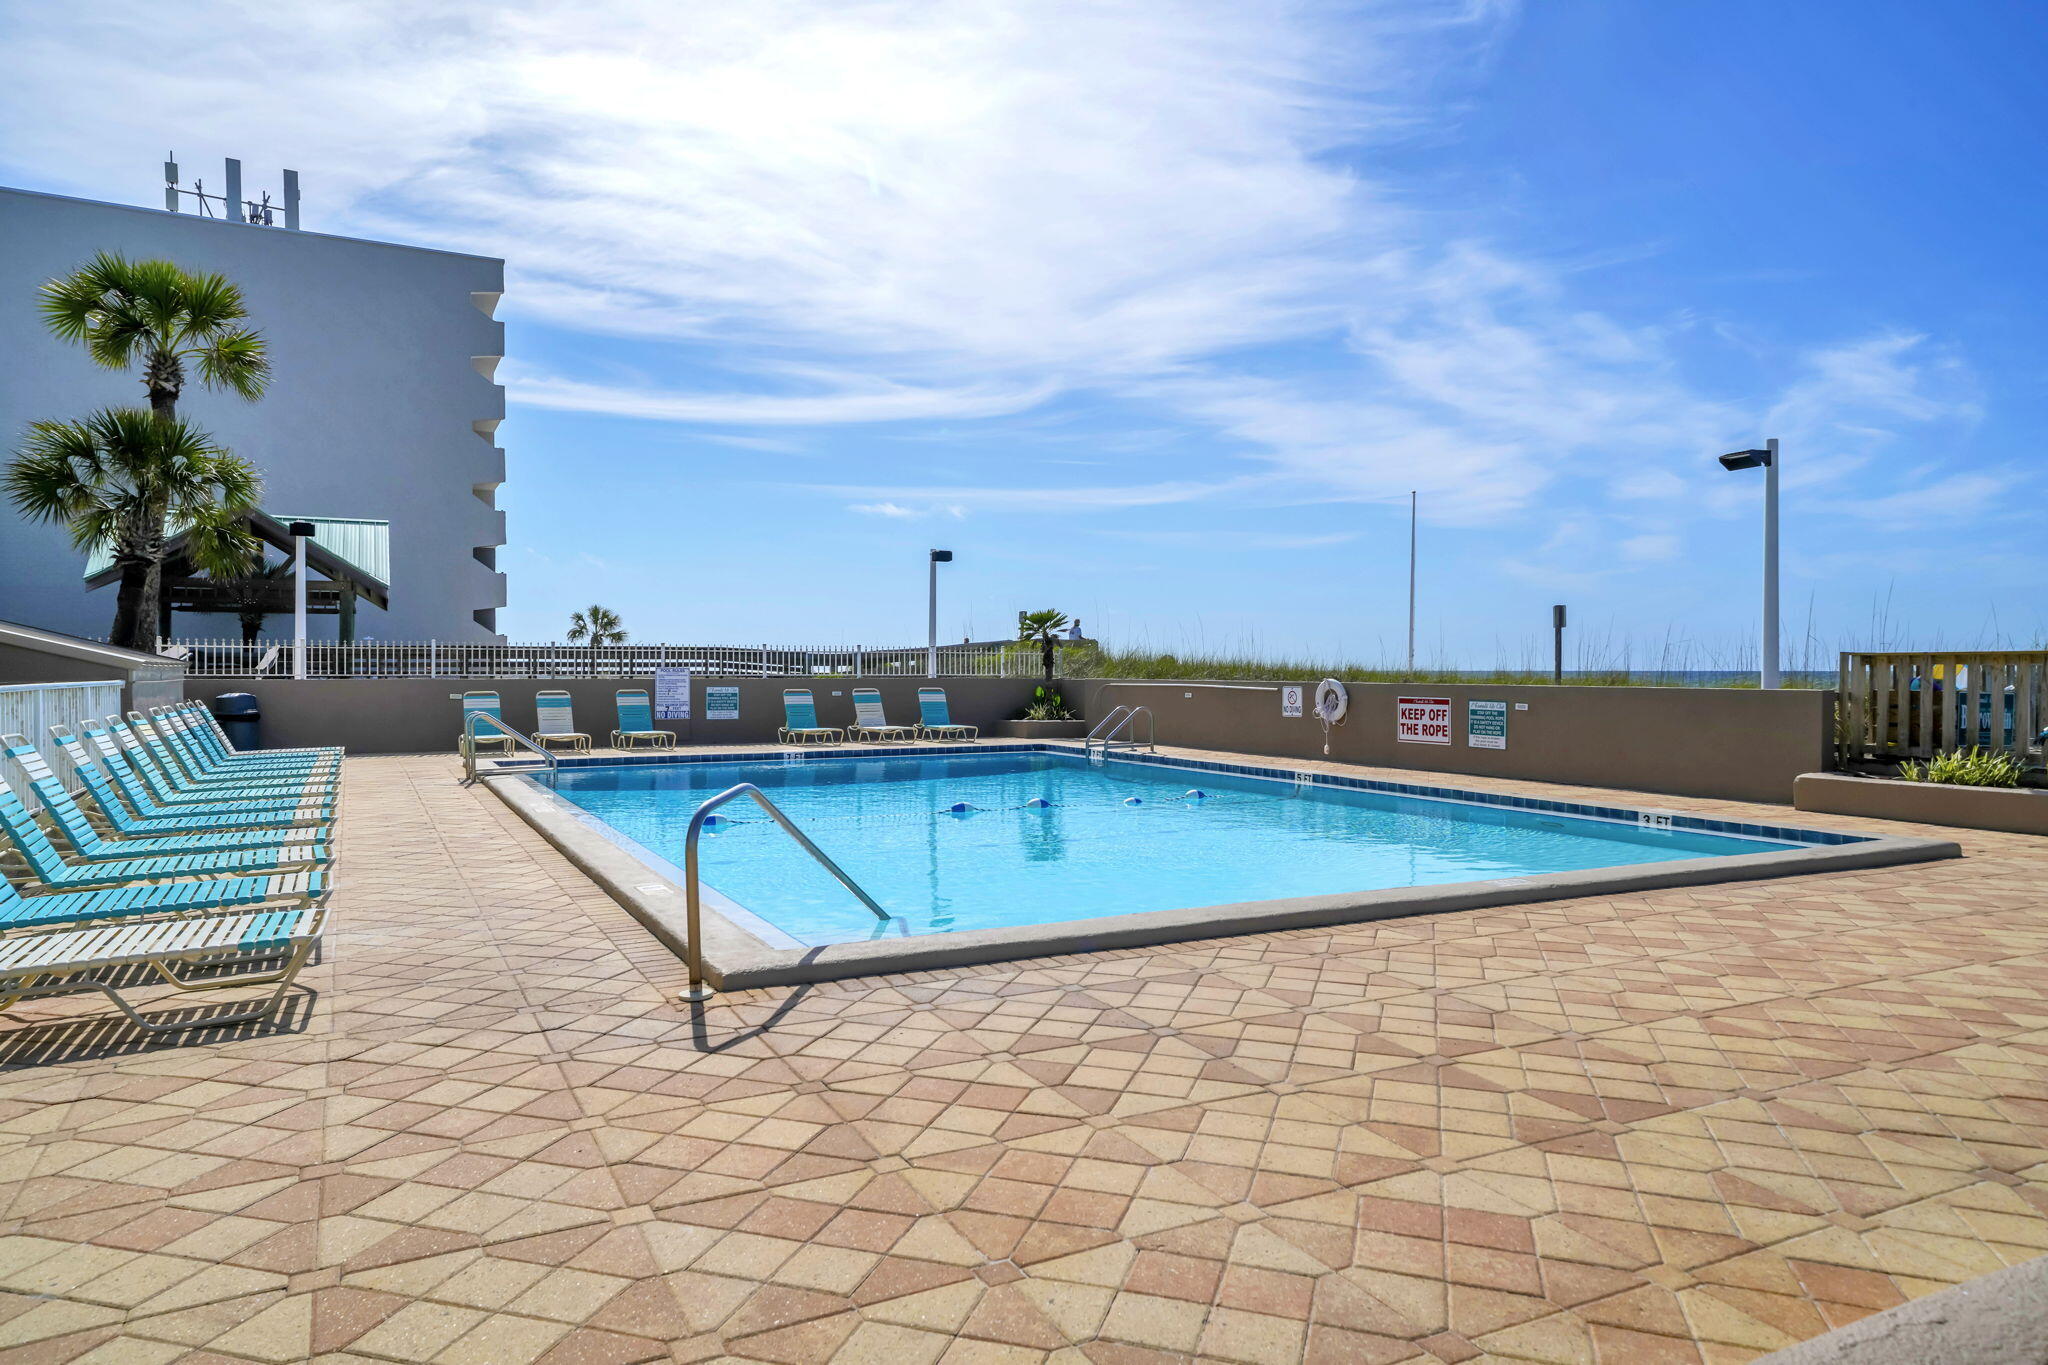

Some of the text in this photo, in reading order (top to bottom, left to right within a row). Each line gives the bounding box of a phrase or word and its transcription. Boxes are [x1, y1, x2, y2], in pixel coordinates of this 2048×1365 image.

[1290, 705, 1302, 714] DIVING
[656, 711, 689, 719] NO DIVING
[1401, 708, 1448, 722] KEEP OFF
[1400, 722, 1448, 737] THE ROPE
[1296, 773, 1312, 783] 5 FT
[1656, 815, 1670, 826] FT
